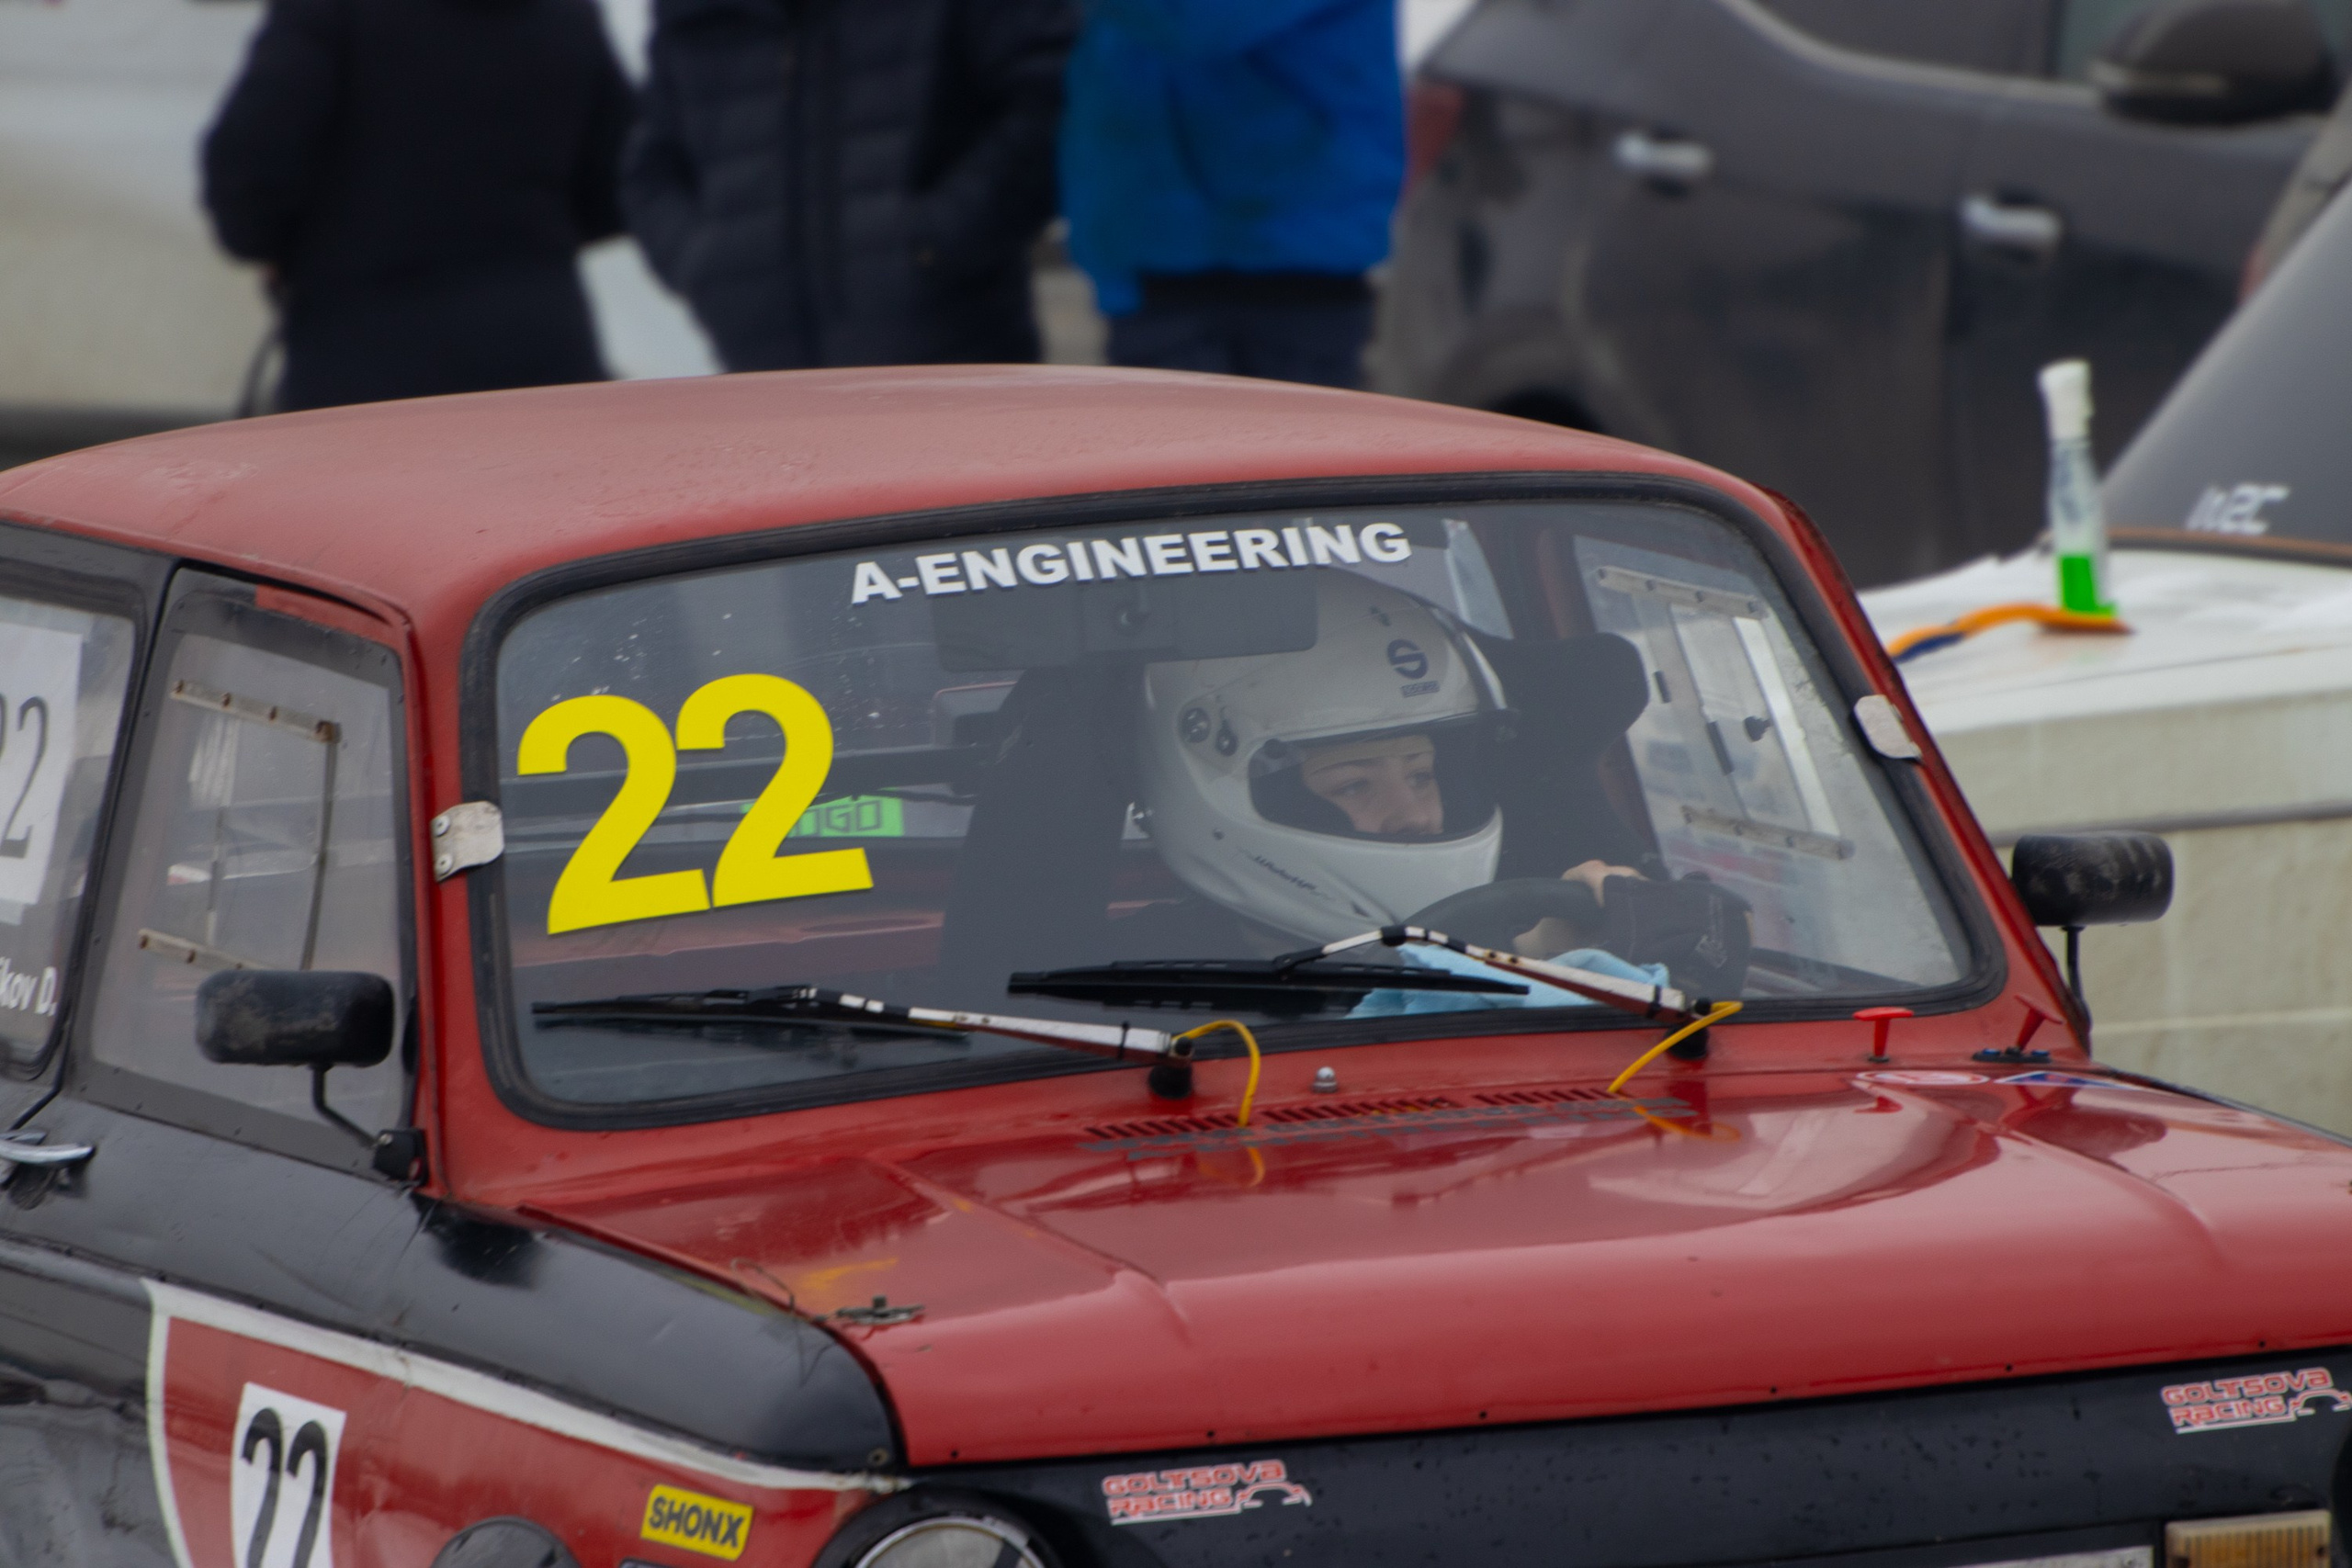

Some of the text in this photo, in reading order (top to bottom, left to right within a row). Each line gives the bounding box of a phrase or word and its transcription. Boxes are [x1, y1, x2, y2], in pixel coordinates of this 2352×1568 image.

[852, 522, 1413, 604] A-ENGINEERING
[0, 693, 48, 858] 2
[517, 673, 874, 935] 22
[0, 956, 39, 1010] kov
[2161, 1367, 2334, 1406] GOLTSOVA
[2169, 1395, 2287, 1427] RACING
[242, 1408, 328, 1568] 22
[1102, 1459, 1286, 1497] GOLTSOVA
[1107, 1487, 1232, 1518] RACING
[649, 1495, 744, 1548] SHONX
